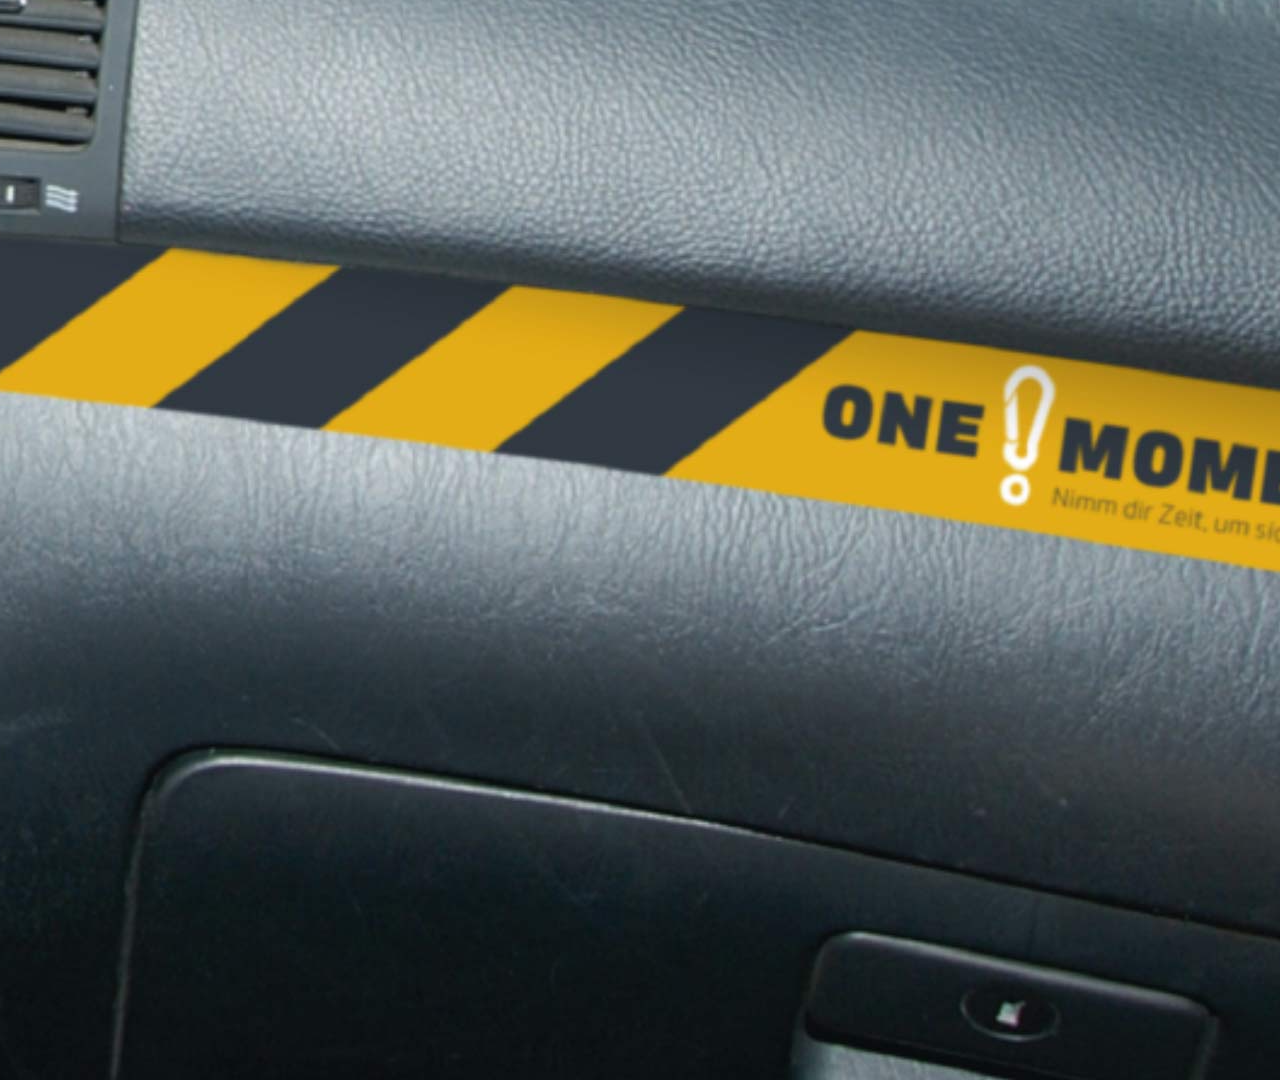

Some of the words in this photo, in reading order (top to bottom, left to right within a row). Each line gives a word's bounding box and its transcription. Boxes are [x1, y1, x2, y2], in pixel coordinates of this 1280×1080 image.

[821, 383, 986, 458] ONE
[1051, 487, 1118, 517] Nimm
[1122, 498, 1153, 521] dir
[1157, 502, 1208, 534] Zeit,
[1213, 516, 1251, 537] um
